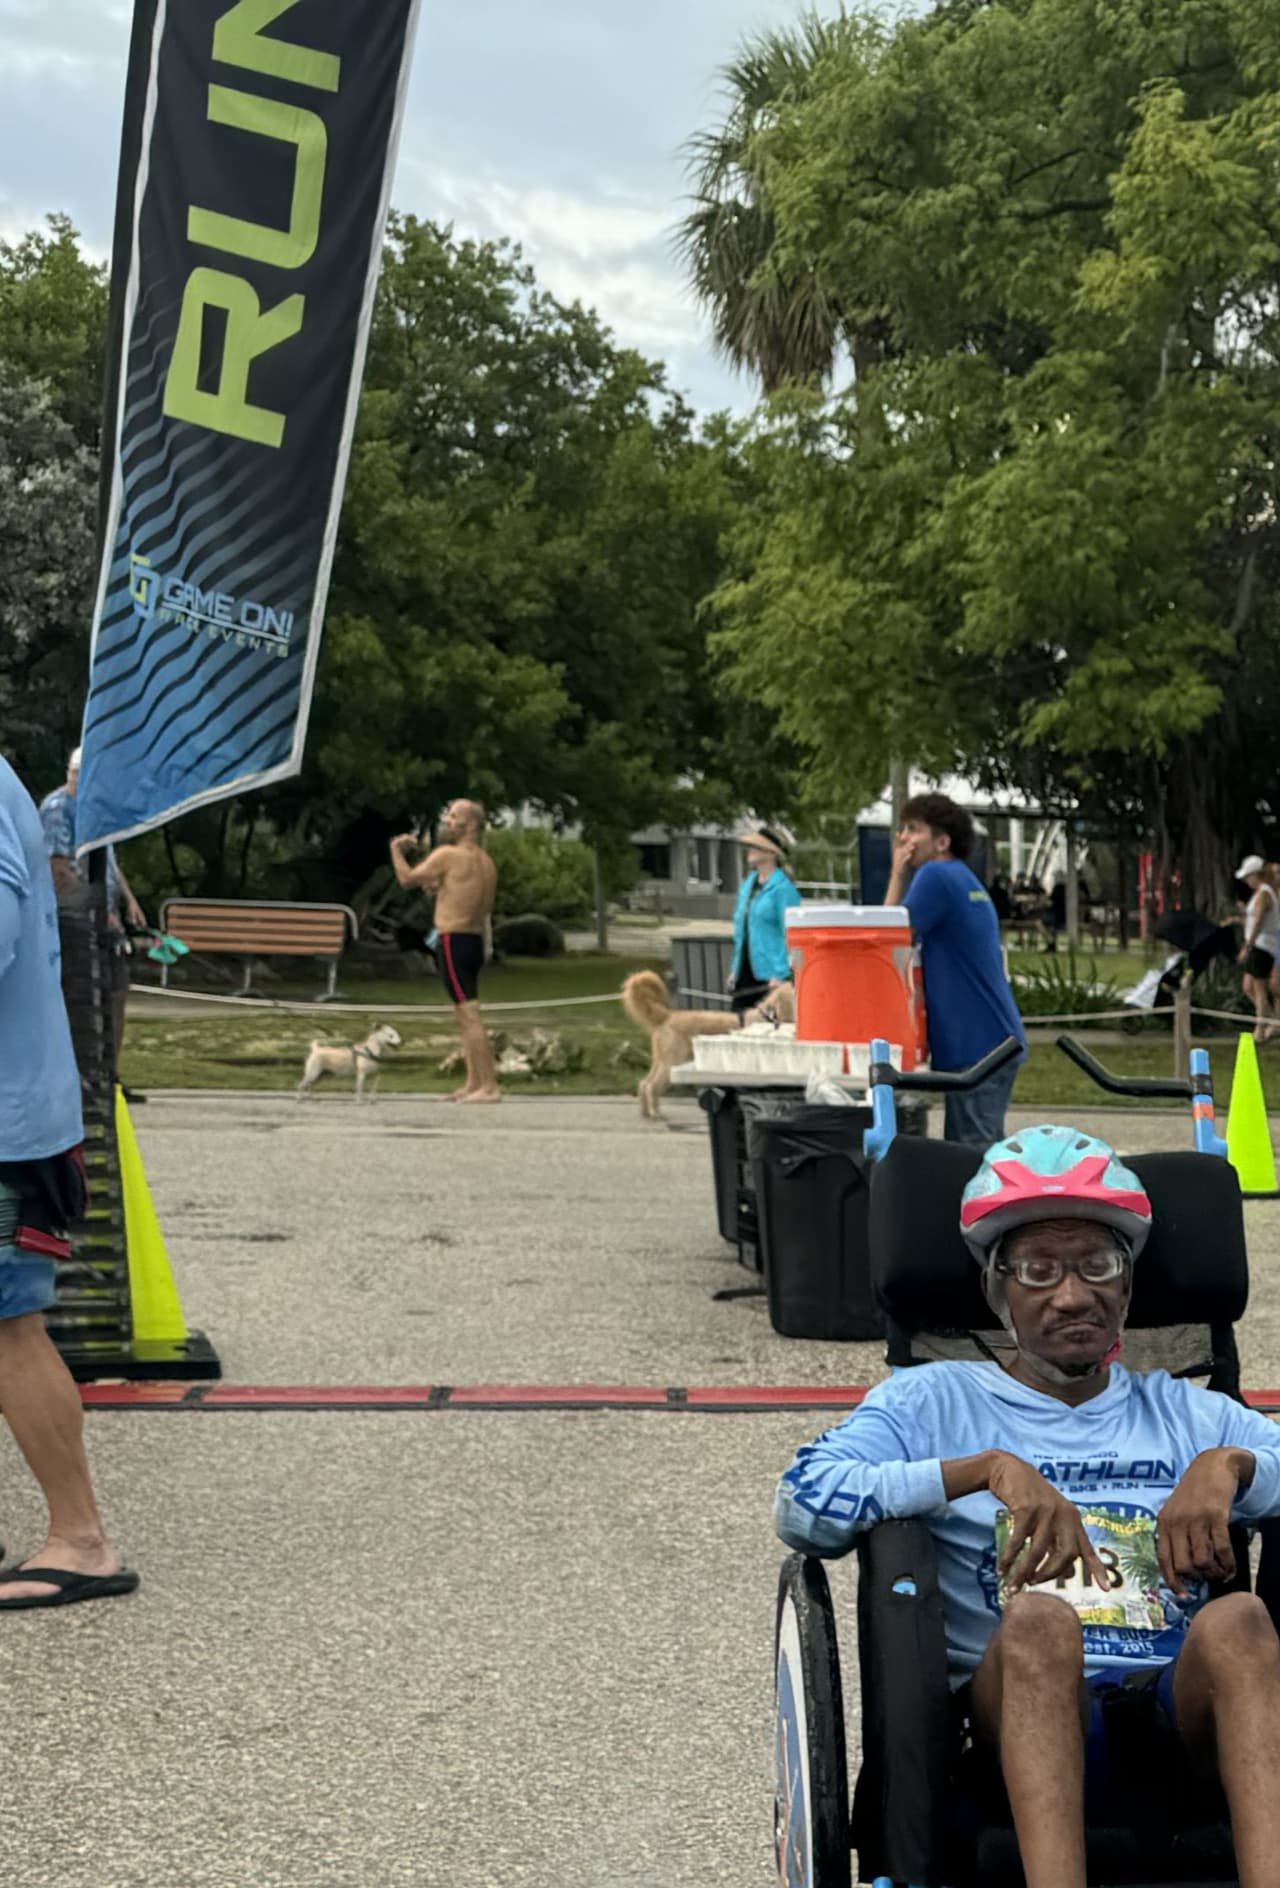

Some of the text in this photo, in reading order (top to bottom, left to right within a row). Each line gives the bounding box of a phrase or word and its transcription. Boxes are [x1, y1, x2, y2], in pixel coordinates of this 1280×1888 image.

[164, 576, 294, 638] GAME ON!
[208, 625, 290, 658] EVENTS
[1112, 1482, 1140, 1491] RUN
[1122, 1642, 1154, 1654] 2015
